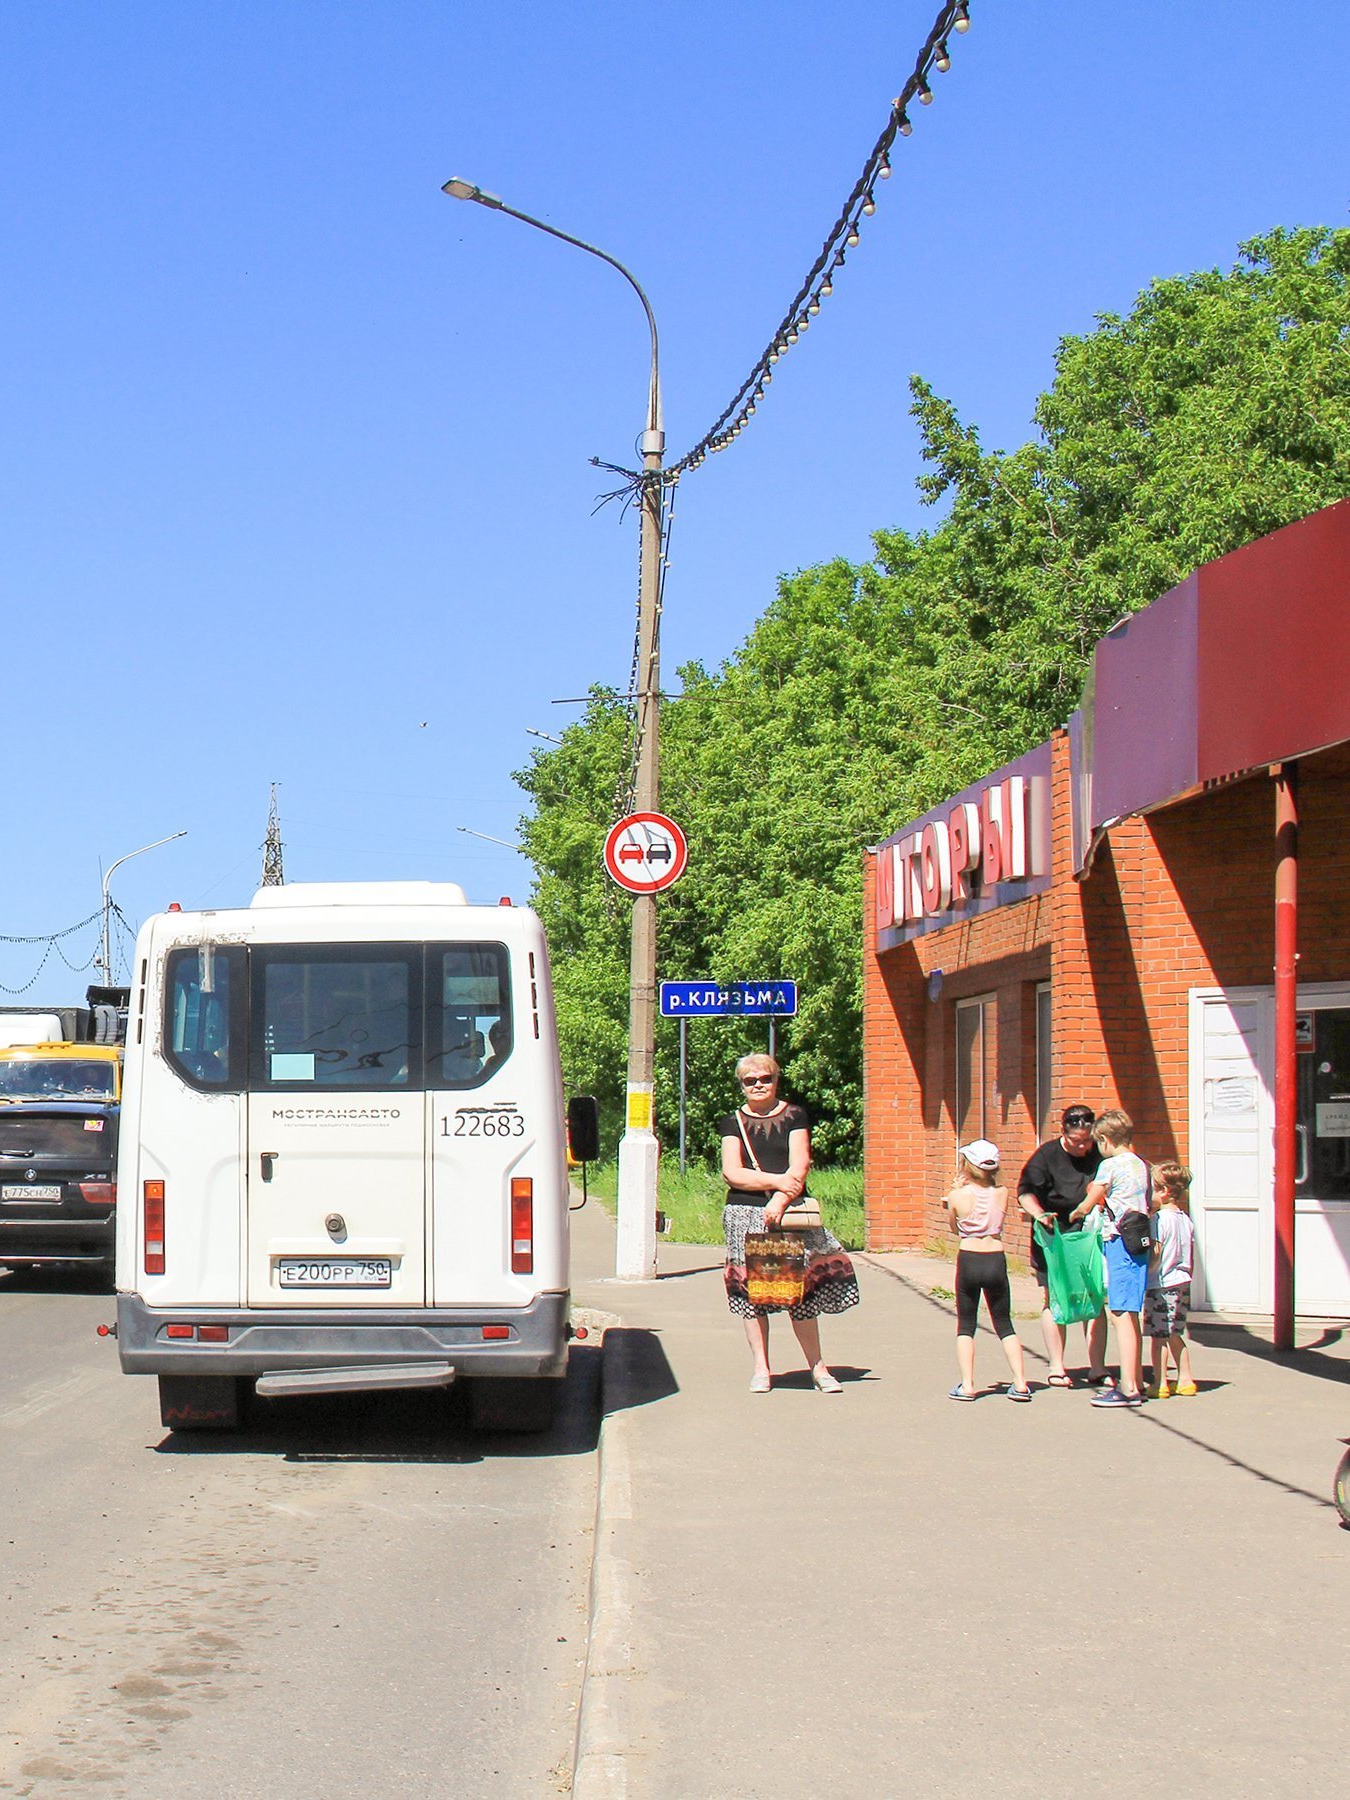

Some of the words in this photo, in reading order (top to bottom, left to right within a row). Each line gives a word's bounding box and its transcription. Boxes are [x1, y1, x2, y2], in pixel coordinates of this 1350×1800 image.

[688, 990, 787, 1006] КЛЯЗЬМА
[272, 1109, 401, 1119] МОСТРАНСАВТО
[440, 1115, 525, 1137] 122683
[286, 1263, 354, 1280] Е200РР
[358, 1262, 385, 1276] 750
